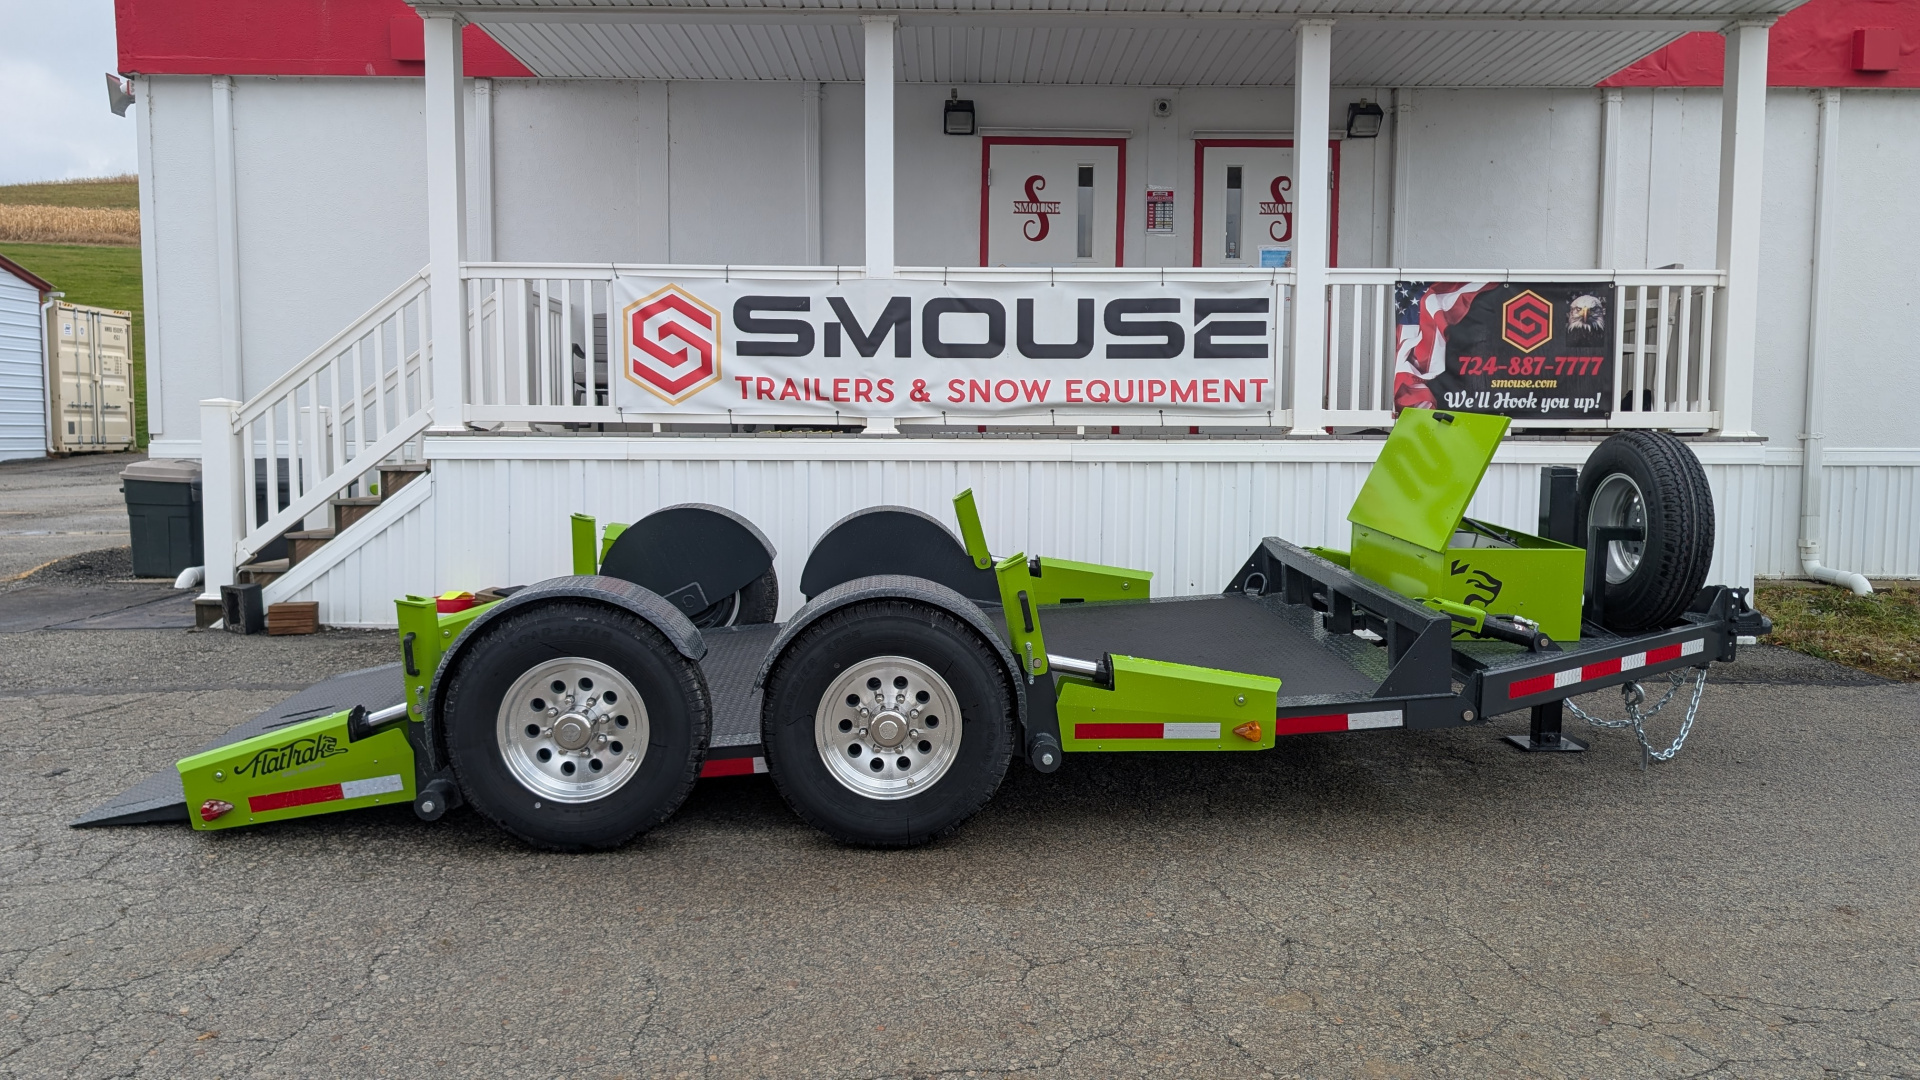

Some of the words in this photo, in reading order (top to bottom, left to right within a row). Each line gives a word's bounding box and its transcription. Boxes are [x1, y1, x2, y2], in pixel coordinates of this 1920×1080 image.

[1013, 202, 1061, 213] SMOUSE
[1259, 203, 1293, 214] SMOU
[732, 294, 1270, 359] SMOUSE
[1458, 356, 1604, 376] 724-887-7777
[735, 376, 895, 402] TRAILERS
[909, 378, 931, 403] &
[947, 378, 1051, 403] SNOW
[1065, 378, 1269, 404] EQUIPMENT
[1491, 378, 1557, 388] smouse.com
[1443, 391, 1490, 408] We'll
[1493, 391, 1538, 409] Hook
[1541, 396, 1569, 412] you
[1573, 392, 1602, 412] up!
